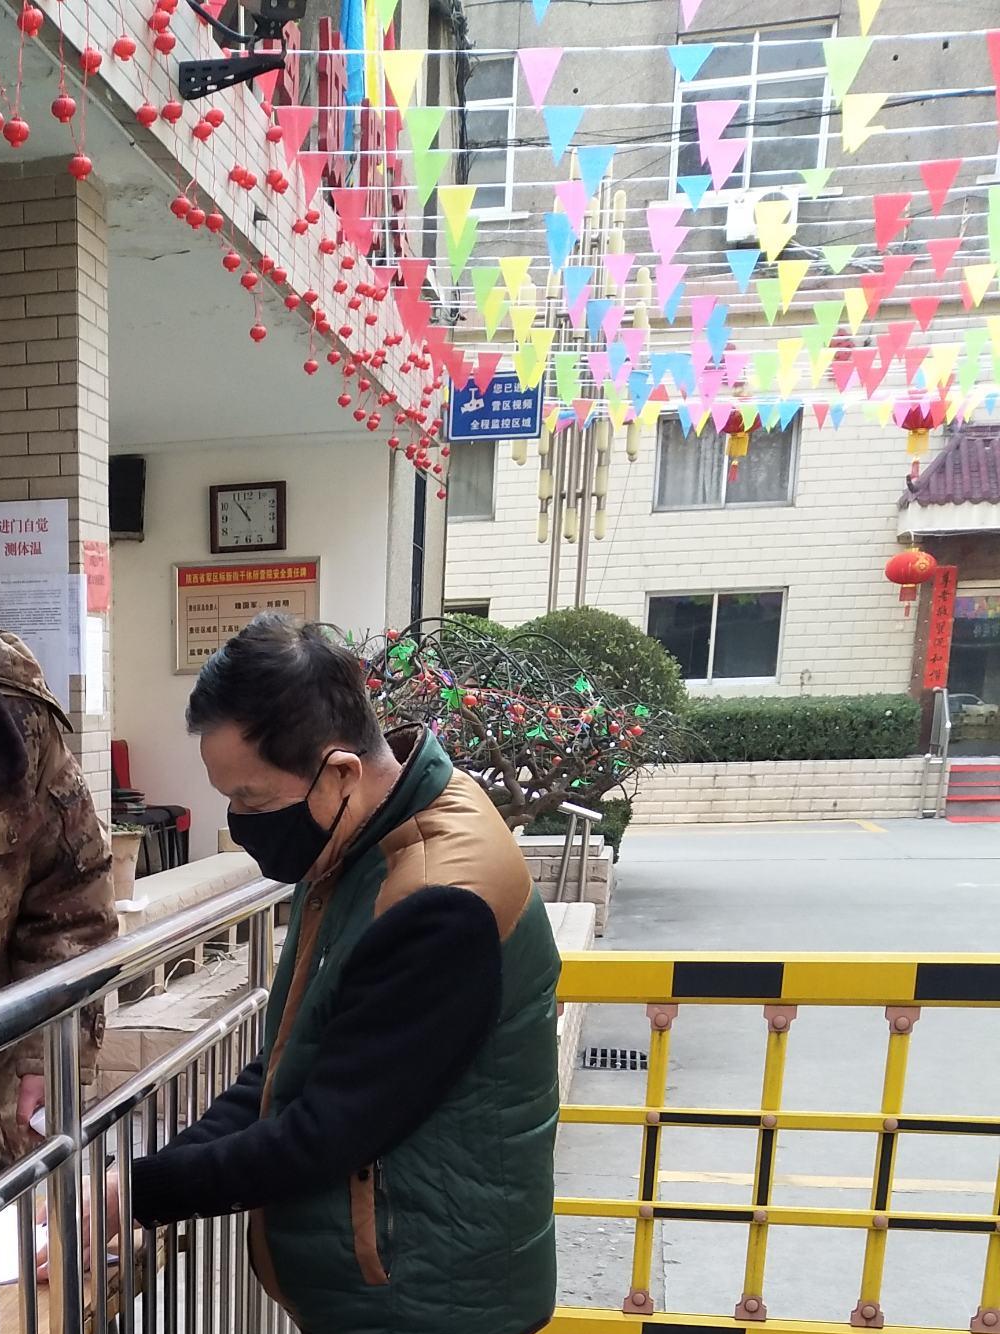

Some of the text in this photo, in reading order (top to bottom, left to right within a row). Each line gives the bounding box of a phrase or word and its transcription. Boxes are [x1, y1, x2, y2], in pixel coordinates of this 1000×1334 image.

[492, 383, 534, 394] 您已进
[491, 399, 533, 412] 营区视频
[470, 417, 532, 430] 全程监控区域
[4, 541, 42, 557] 测体温
